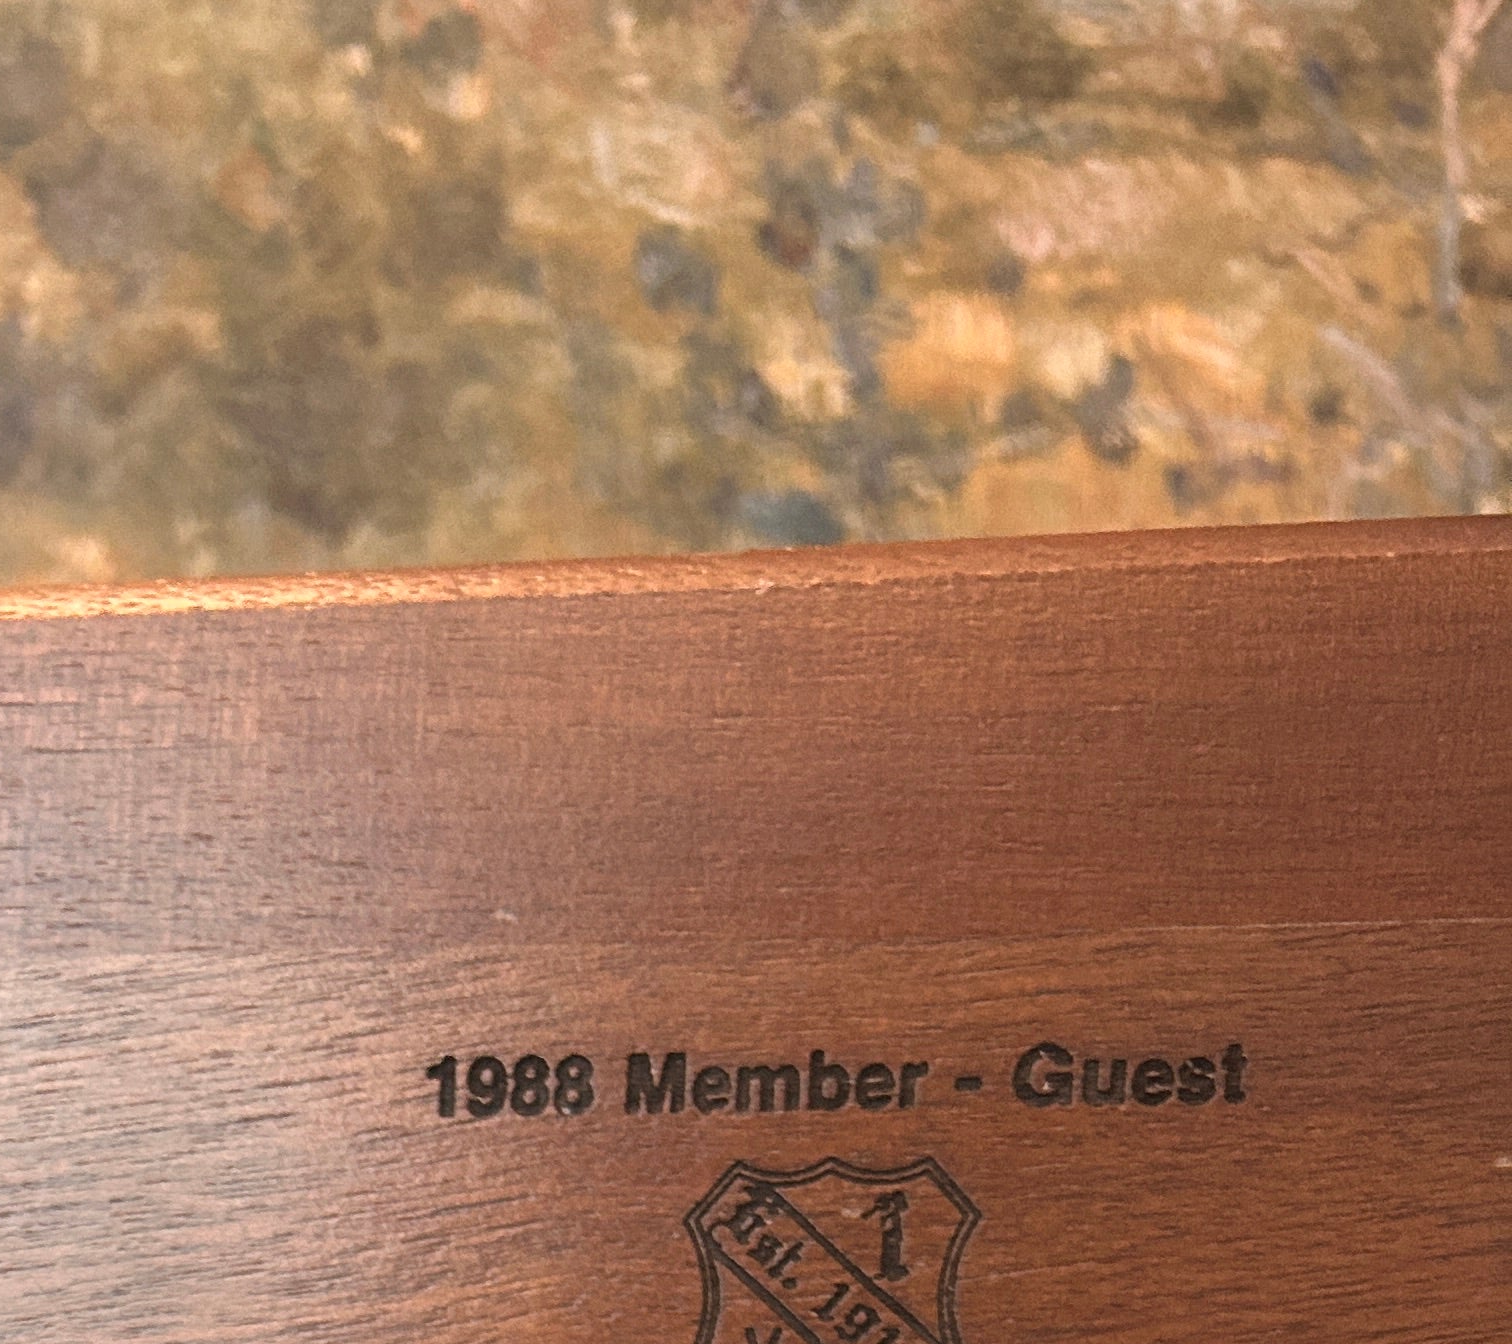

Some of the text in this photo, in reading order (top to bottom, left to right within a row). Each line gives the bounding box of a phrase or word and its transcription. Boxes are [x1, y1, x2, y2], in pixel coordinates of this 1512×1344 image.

[426, 1053, 594, 1118] 1988
[624, 1050, 927, 1116] Member
[1011, 1041, 1249, 1108] Guest
[707, 1184, 805, 1290] Est.
